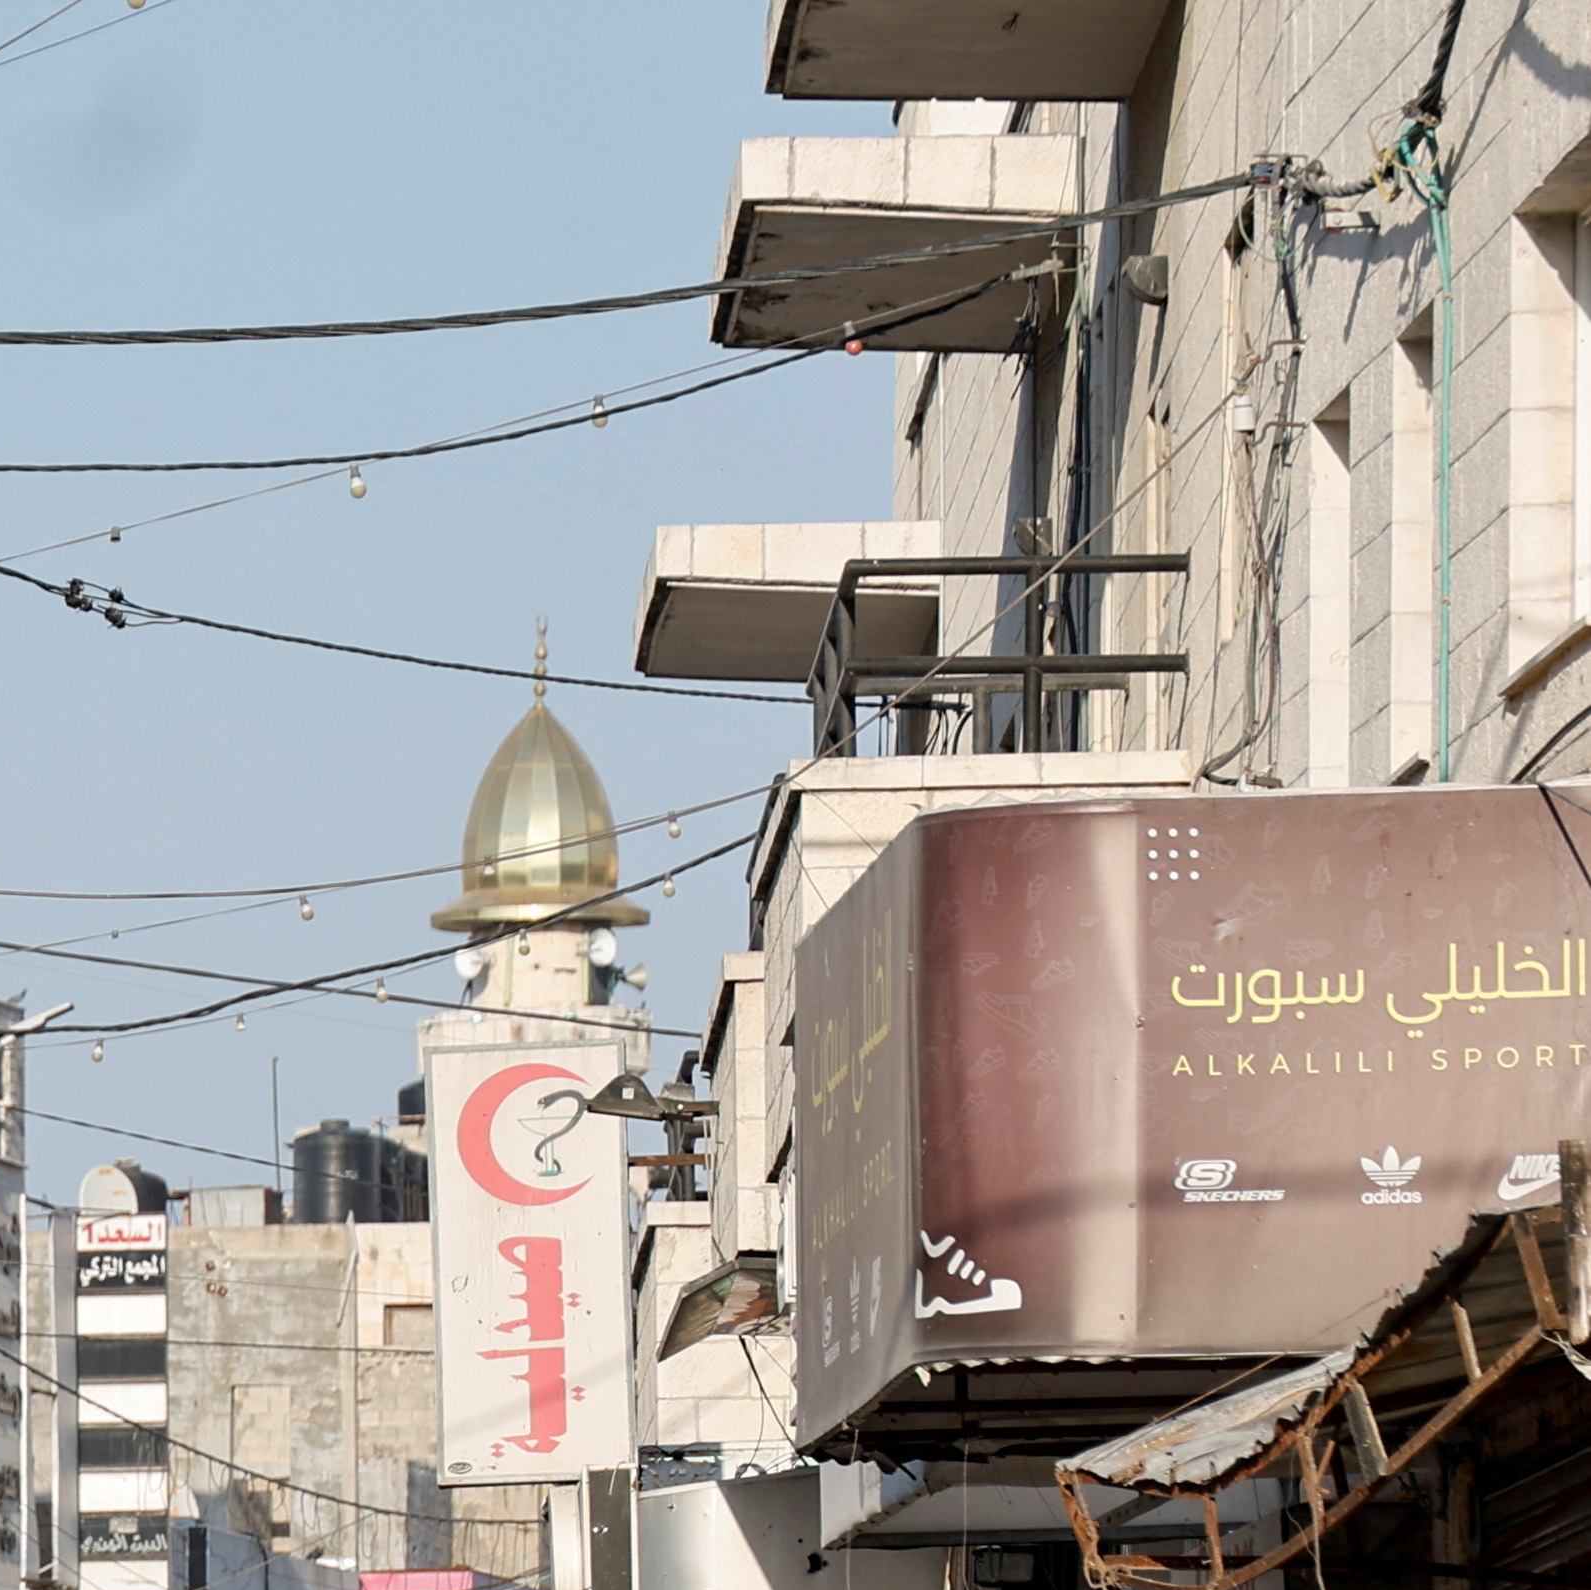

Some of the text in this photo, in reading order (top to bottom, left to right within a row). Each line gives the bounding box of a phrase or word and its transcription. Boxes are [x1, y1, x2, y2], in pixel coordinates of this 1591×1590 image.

[1170, 937, 1587, 1039] الخليلي سبورت
[1171, 1043, 1587, 1077] ALKALILI SPORT
[1509, 1154, 1561, 1180] NIKE
[1182, 1189, 1286, 1204] SKECHERS
[1360, 1189, 1423, 1205] adidas
[474, 1235, 587, 1459] صيدلية
